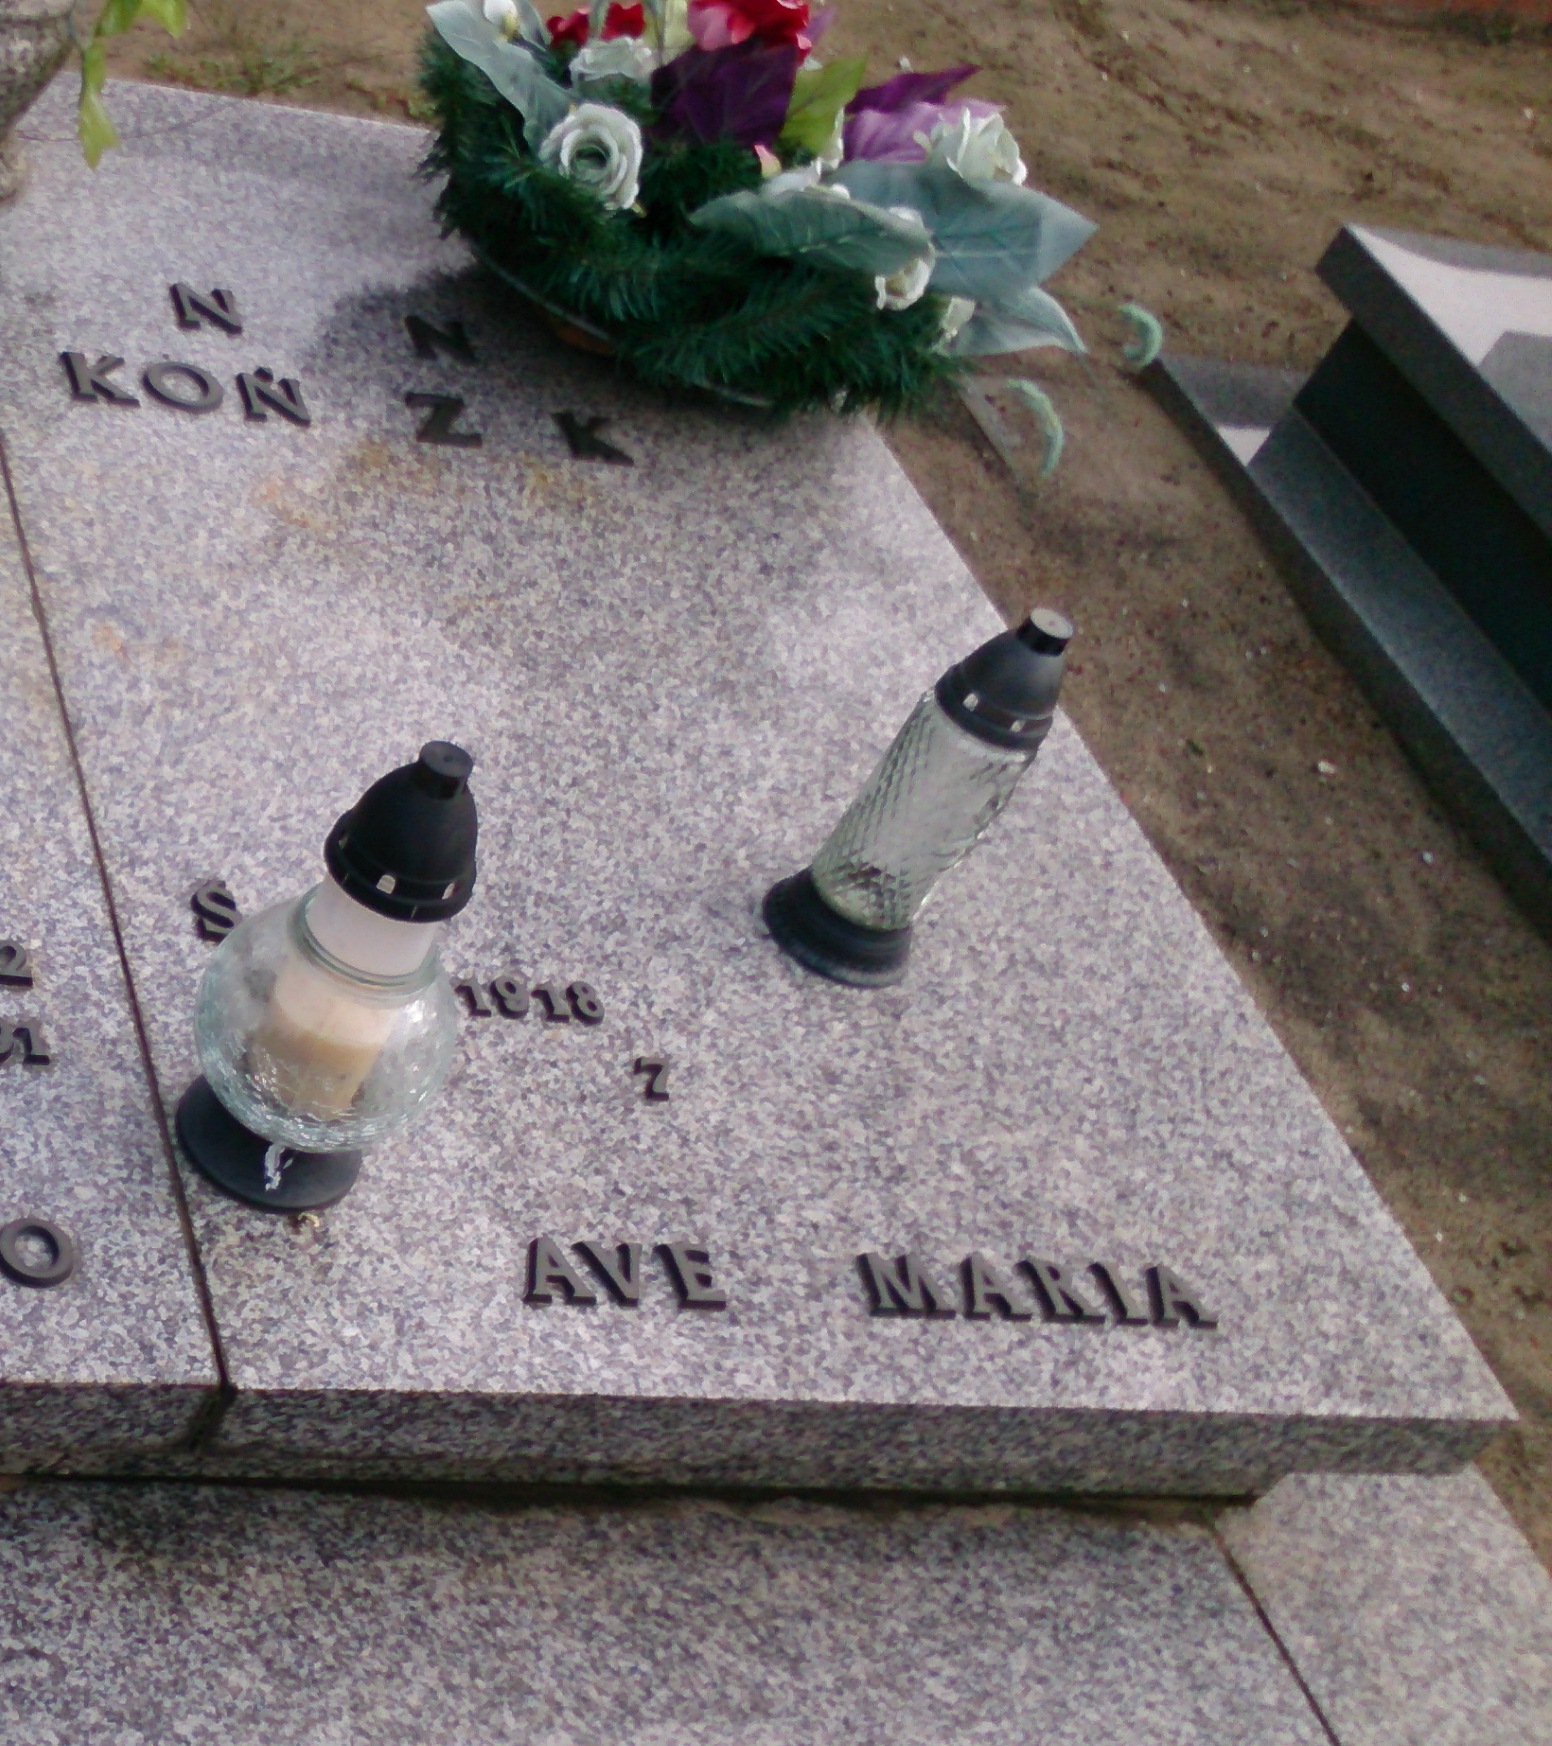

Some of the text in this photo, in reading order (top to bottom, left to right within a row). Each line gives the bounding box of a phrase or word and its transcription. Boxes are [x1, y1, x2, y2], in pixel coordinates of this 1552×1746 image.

[58, 351, 311, 428] KOŃ
[454, 974, 605, 1027] 1918
[522, 1237, 1218, 1330] AVE MARIA
